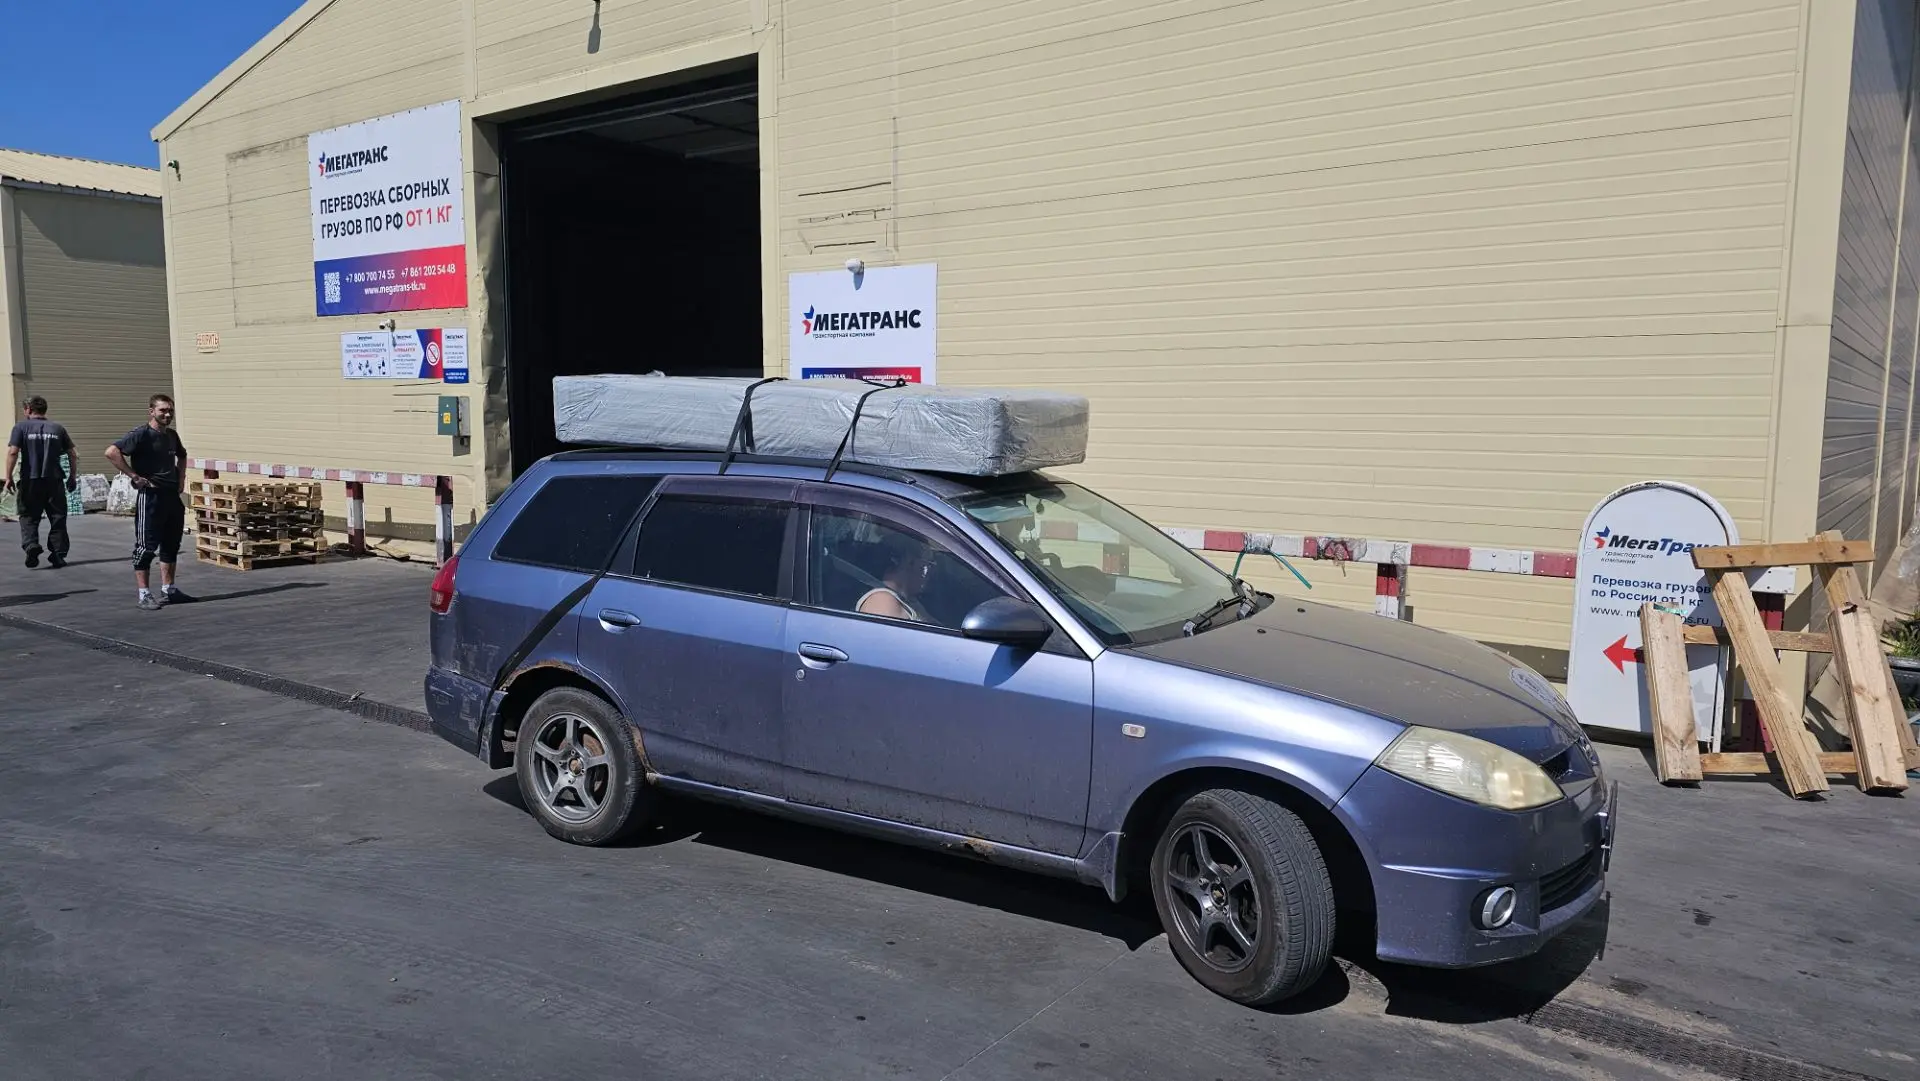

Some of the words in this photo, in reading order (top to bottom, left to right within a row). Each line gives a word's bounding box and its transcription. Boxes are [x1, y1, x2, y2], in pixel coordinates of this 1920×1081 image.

[325, 145, 389, 173] МЕГАТРАНС
[320, 189, 386, 214] ПЕРЕВОЗКА
[388, 178, 450, 202] СБОРНЫХ
[321, 218, 362, 239] ГРУЗОВ
[365, 215, 382, 233] ПО
[386, 212, 403, 230] РФ
[406, 209, 423, 228] ОТ
[426, 207, 432, 225] 1
[437, 205, 453, 224] КГ
[345, 273, 353, 283] +7
[354, 271, 366, 283] 800
[366, 270, 378, 282] 700
[378, 270, 386, 280] 74
[387, 269, 395, 279] 55
[401, 267, 409, 278] +7
[410, 266, 422, 277] 861
[424, 265, 437, 276] 202
[437, 264, 446, 275] 54
[446, 263, 456, 274] 48
[364, 282, 426, 296] www.megatrans-tk.ru
[813, 309, 922, 331] МЕГАТРАНС
[812, 332, 849, 340] транспортная
[1604, 550, 1654, 559] транспортная
[1608, 535, 1720, 556] МегаТра
[1601, 557, 1636, 565] компания
[1592, 574, 1662, 590] Перевозка
[1666, 583, 1712, 595] грузов
[1591, 589, 1606, 598] по
[1610, 590, 1658, 602] России
[1661, 596, 1676, 604] от
[1680, 596, 1685, 605] 1
[1689, 598, 1704, 607] кг
